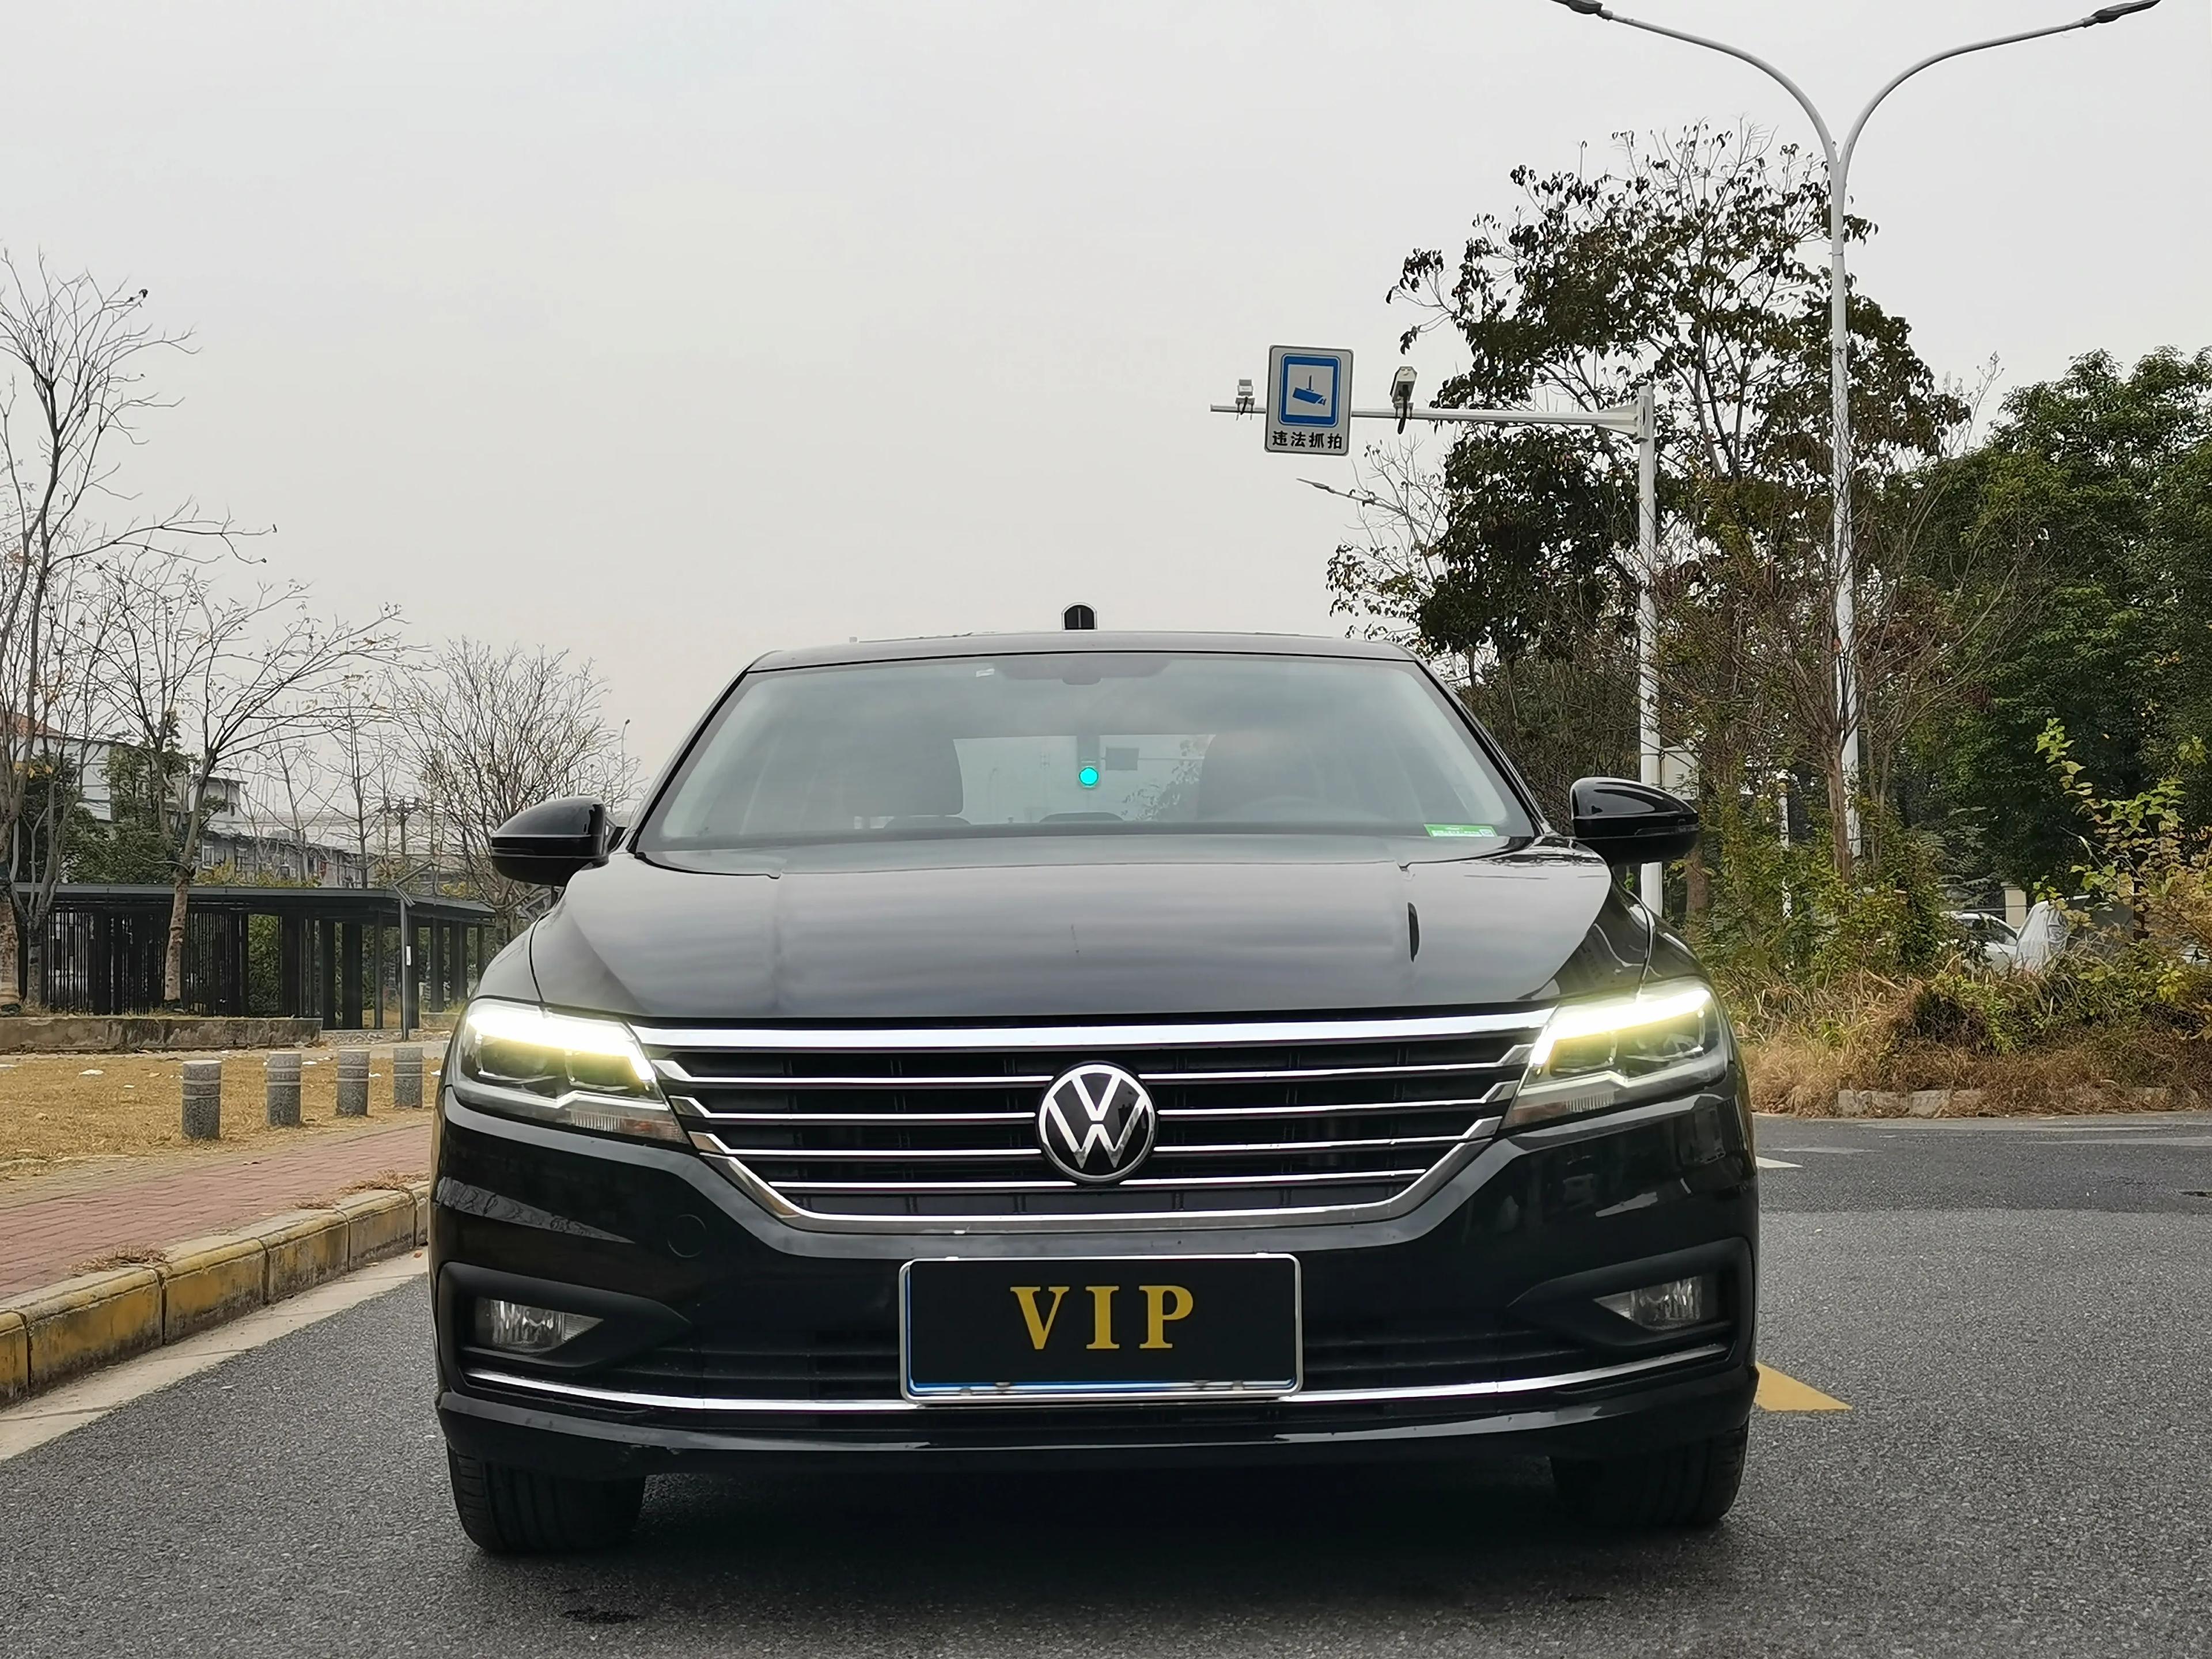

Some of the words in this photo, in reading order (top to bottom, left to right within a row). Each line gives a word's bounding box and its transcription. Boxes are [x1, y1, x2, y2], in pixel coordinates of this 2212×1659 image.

[1272, 430, 1342, 449] 违法抓拍
[1010, 1285, 1194, 1350] VIP
